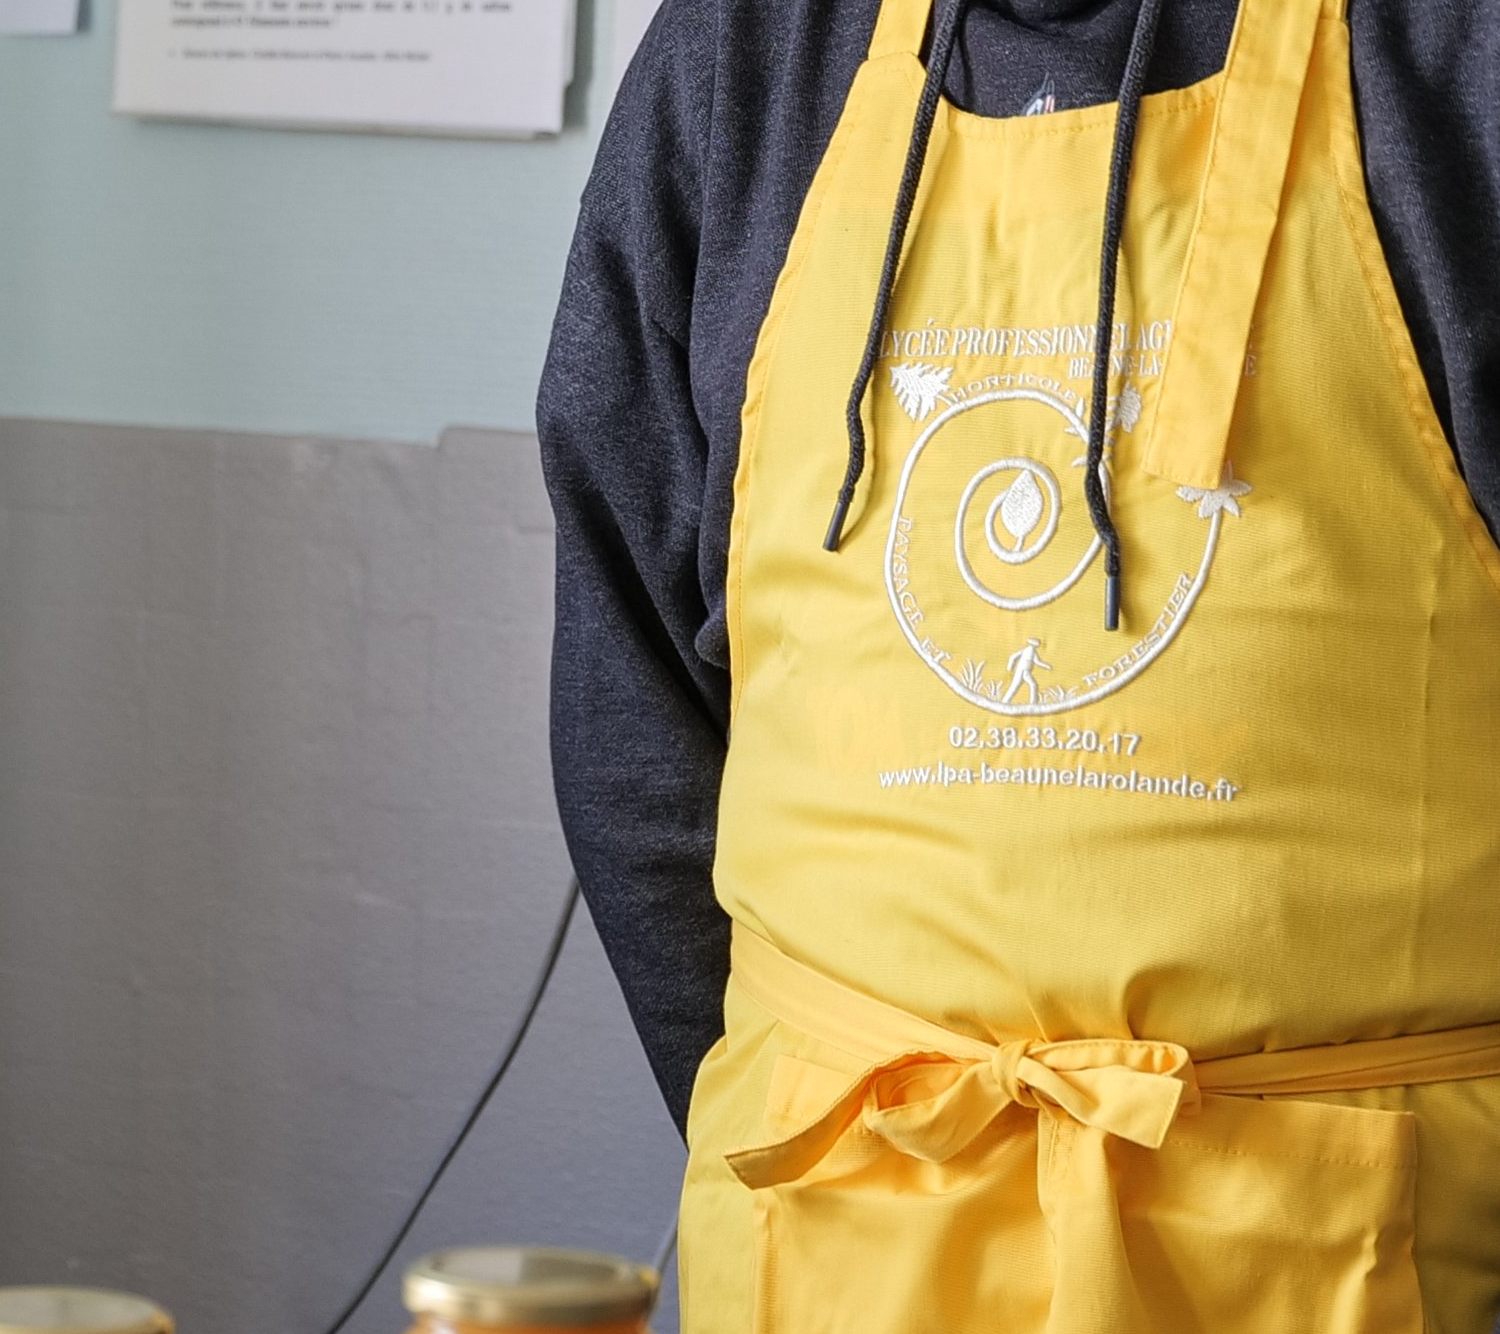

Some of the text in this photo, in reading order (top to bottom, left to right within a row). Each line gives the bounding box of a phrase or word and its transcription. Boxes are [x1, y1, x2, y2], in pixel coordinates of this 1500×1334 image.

[952, 372, 1079, 405] HORTICOLE
[890, 516, 953, 666] PAYSAGE ET
[1081, 570, 1196, 689] FORESTIER
[947, 724, 1143, 758] 02.38.33.20.17
[877, 759, 1242, 804] www.lpa-beaunelarolande.fr
